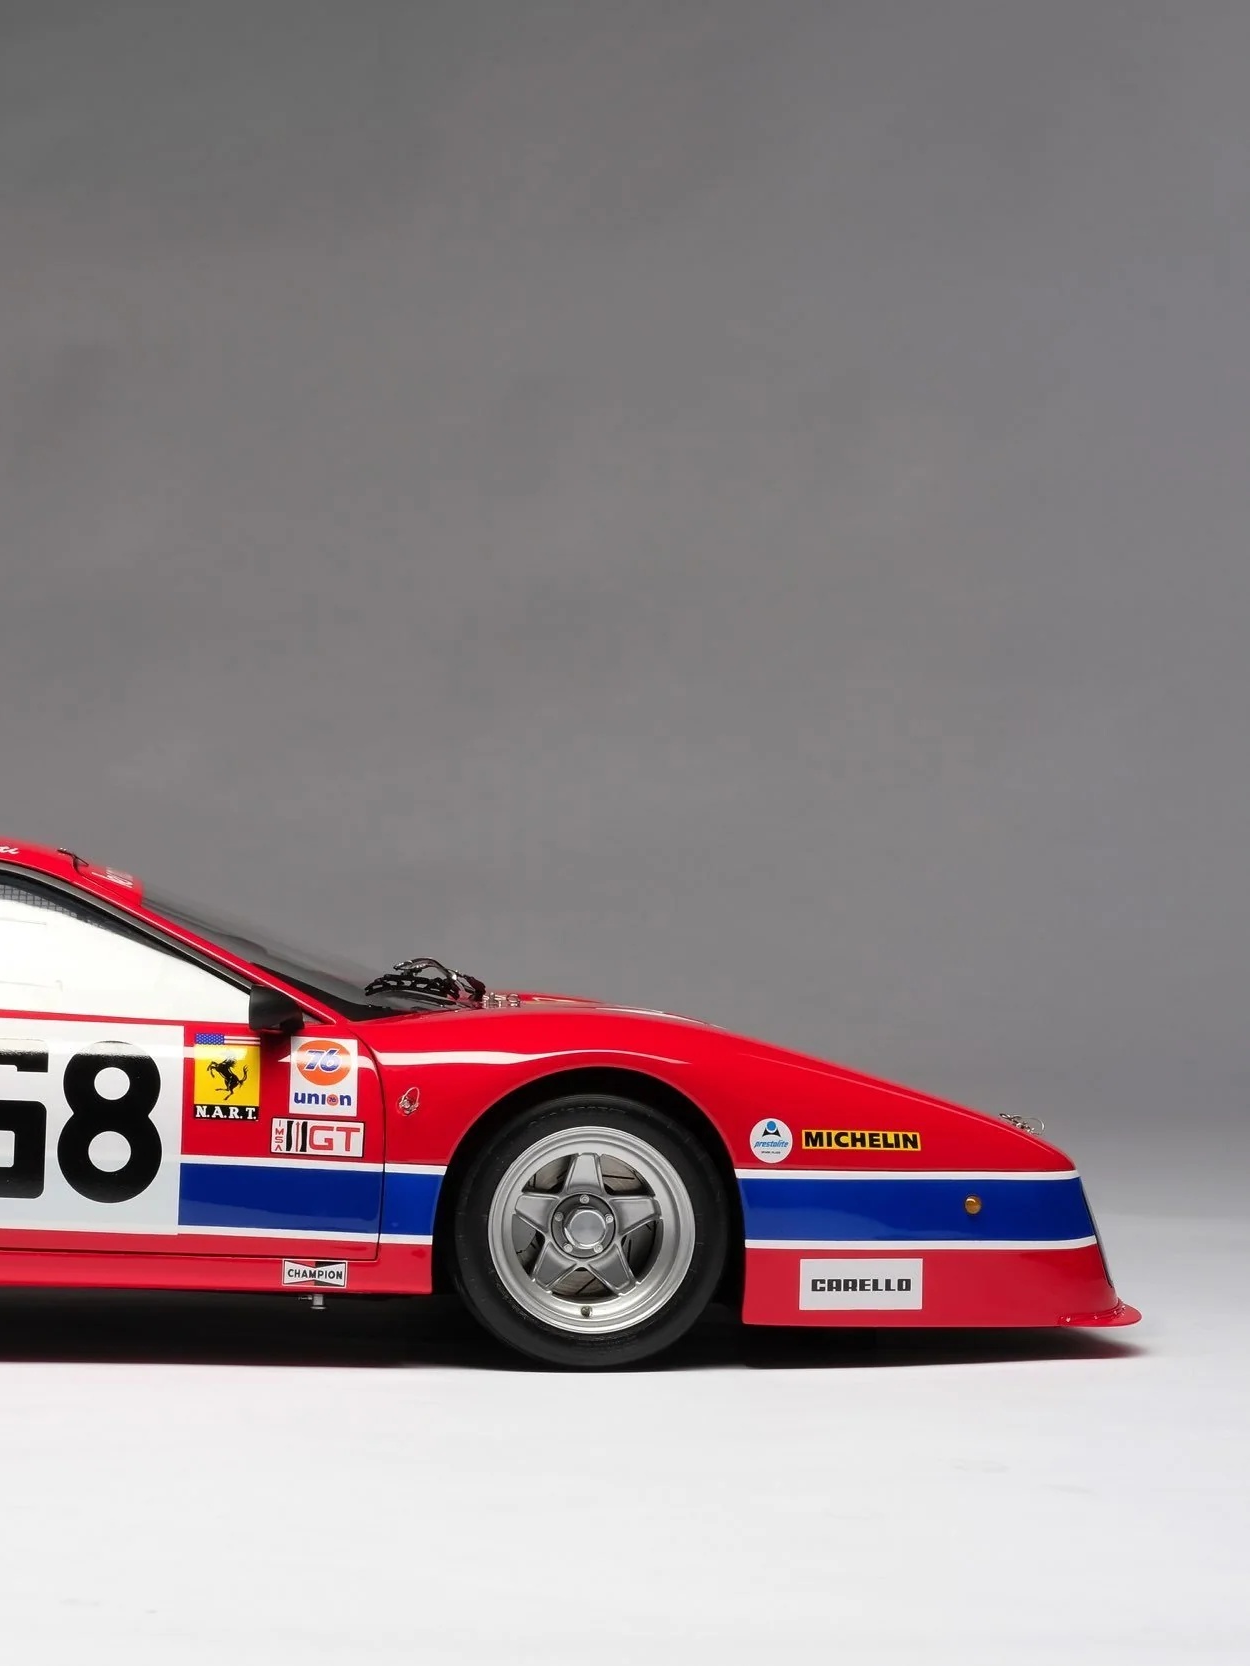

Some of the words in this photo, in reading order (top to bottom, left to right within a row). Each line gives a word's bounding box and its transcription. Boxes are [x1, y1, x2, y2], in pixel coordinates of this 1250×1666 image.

[304, 1048, 343, 1072] 76
[309, 1125, 361, 1152] GT
[754, 1139, 789, 1149] prestolite
[804, 1131, 919, 1149] MICHELIN
[287, 1268, 343, 1280] CHAMPION
[811, 1278, 912, 1292] CARELLO
